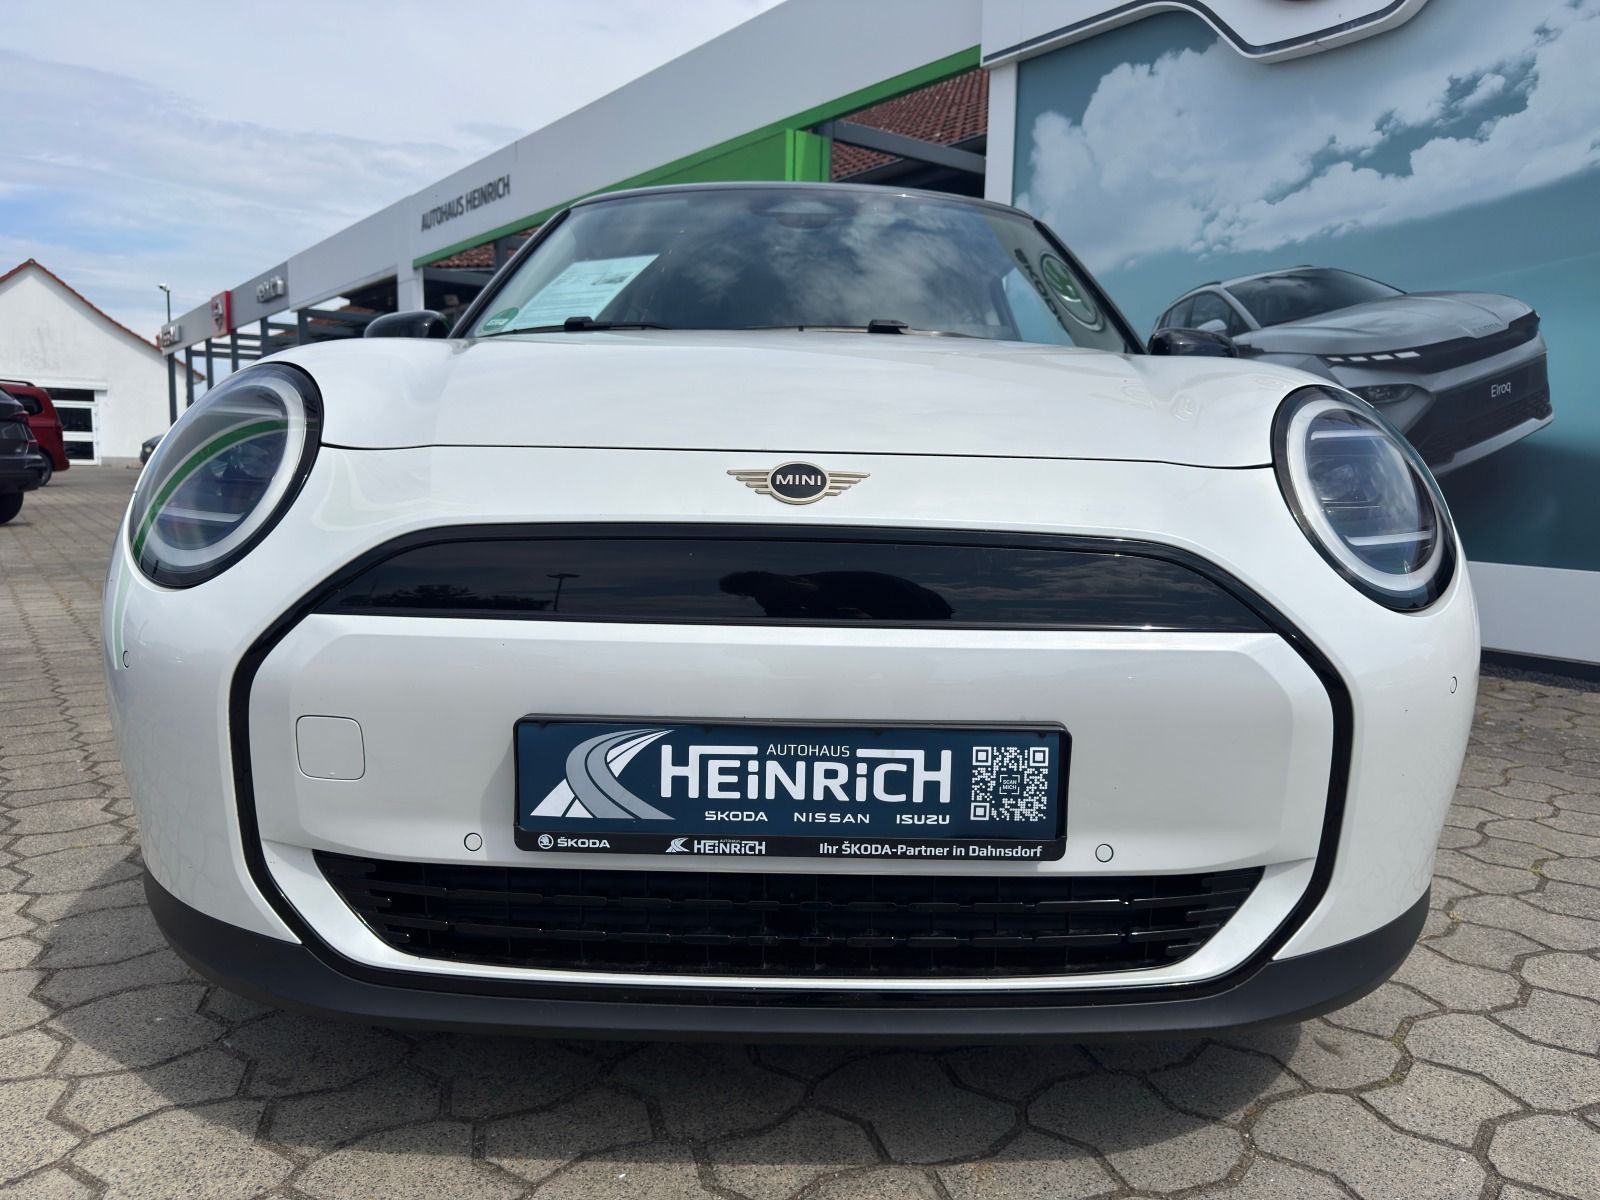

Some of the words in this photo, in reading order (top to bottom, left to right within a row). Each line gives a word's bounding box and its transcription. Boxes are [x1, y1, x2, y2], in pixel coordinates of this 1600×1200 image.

[421, 195, 464, 232] AUTOHAUS
[465, 174, 511, 213] HEINRICH
[1491, 381, 1512, 398] Elroq
[775, 474, 822, 486] MINI
[766, 743, 850, 757] AUTOHAUS
[793, 812, 870, 824] NISSAN
[896, 814, 950, 825] ISUZU
[557, 836, 611, 849] ŠKODA
[819, 842, 839, 854] Ihr
[841, 840, 950, 856] ŠKODA-Partner
[952, 844, 965, 856] in
[968, 845, 1043, 858] Dahnsdorf
